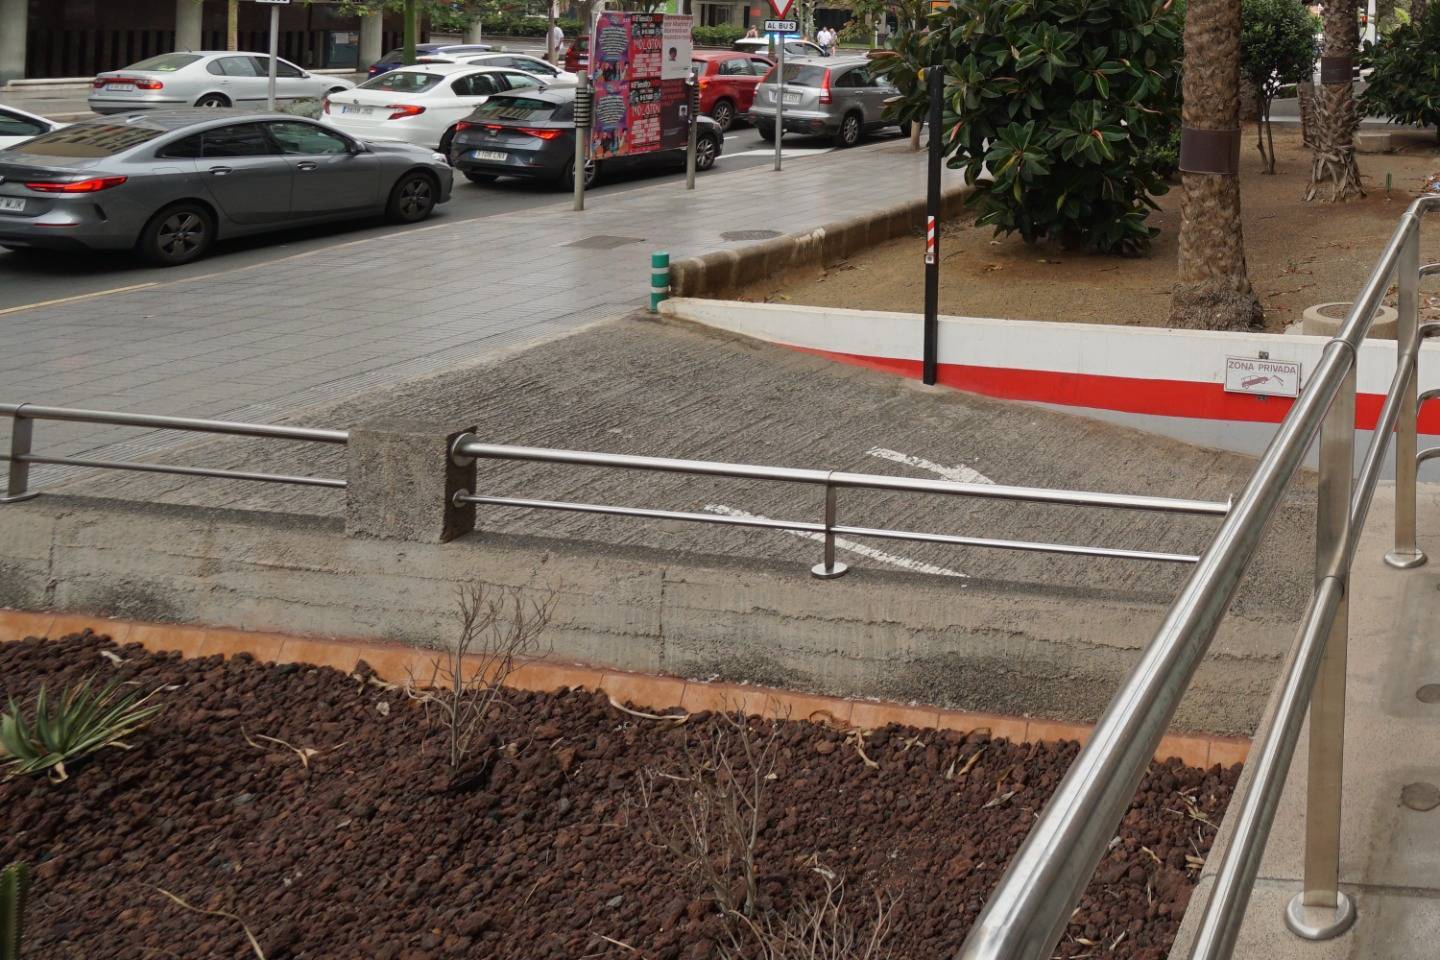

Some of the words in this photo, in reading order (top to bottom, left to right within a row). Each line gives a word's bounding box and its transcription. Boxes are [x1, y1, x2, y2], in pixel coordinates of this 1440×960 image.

[778, 22, 794, 30] BUS
[1228, 360, 1254, 371] ZONA
[1258, 363, 1296, 375] PRIVADA
